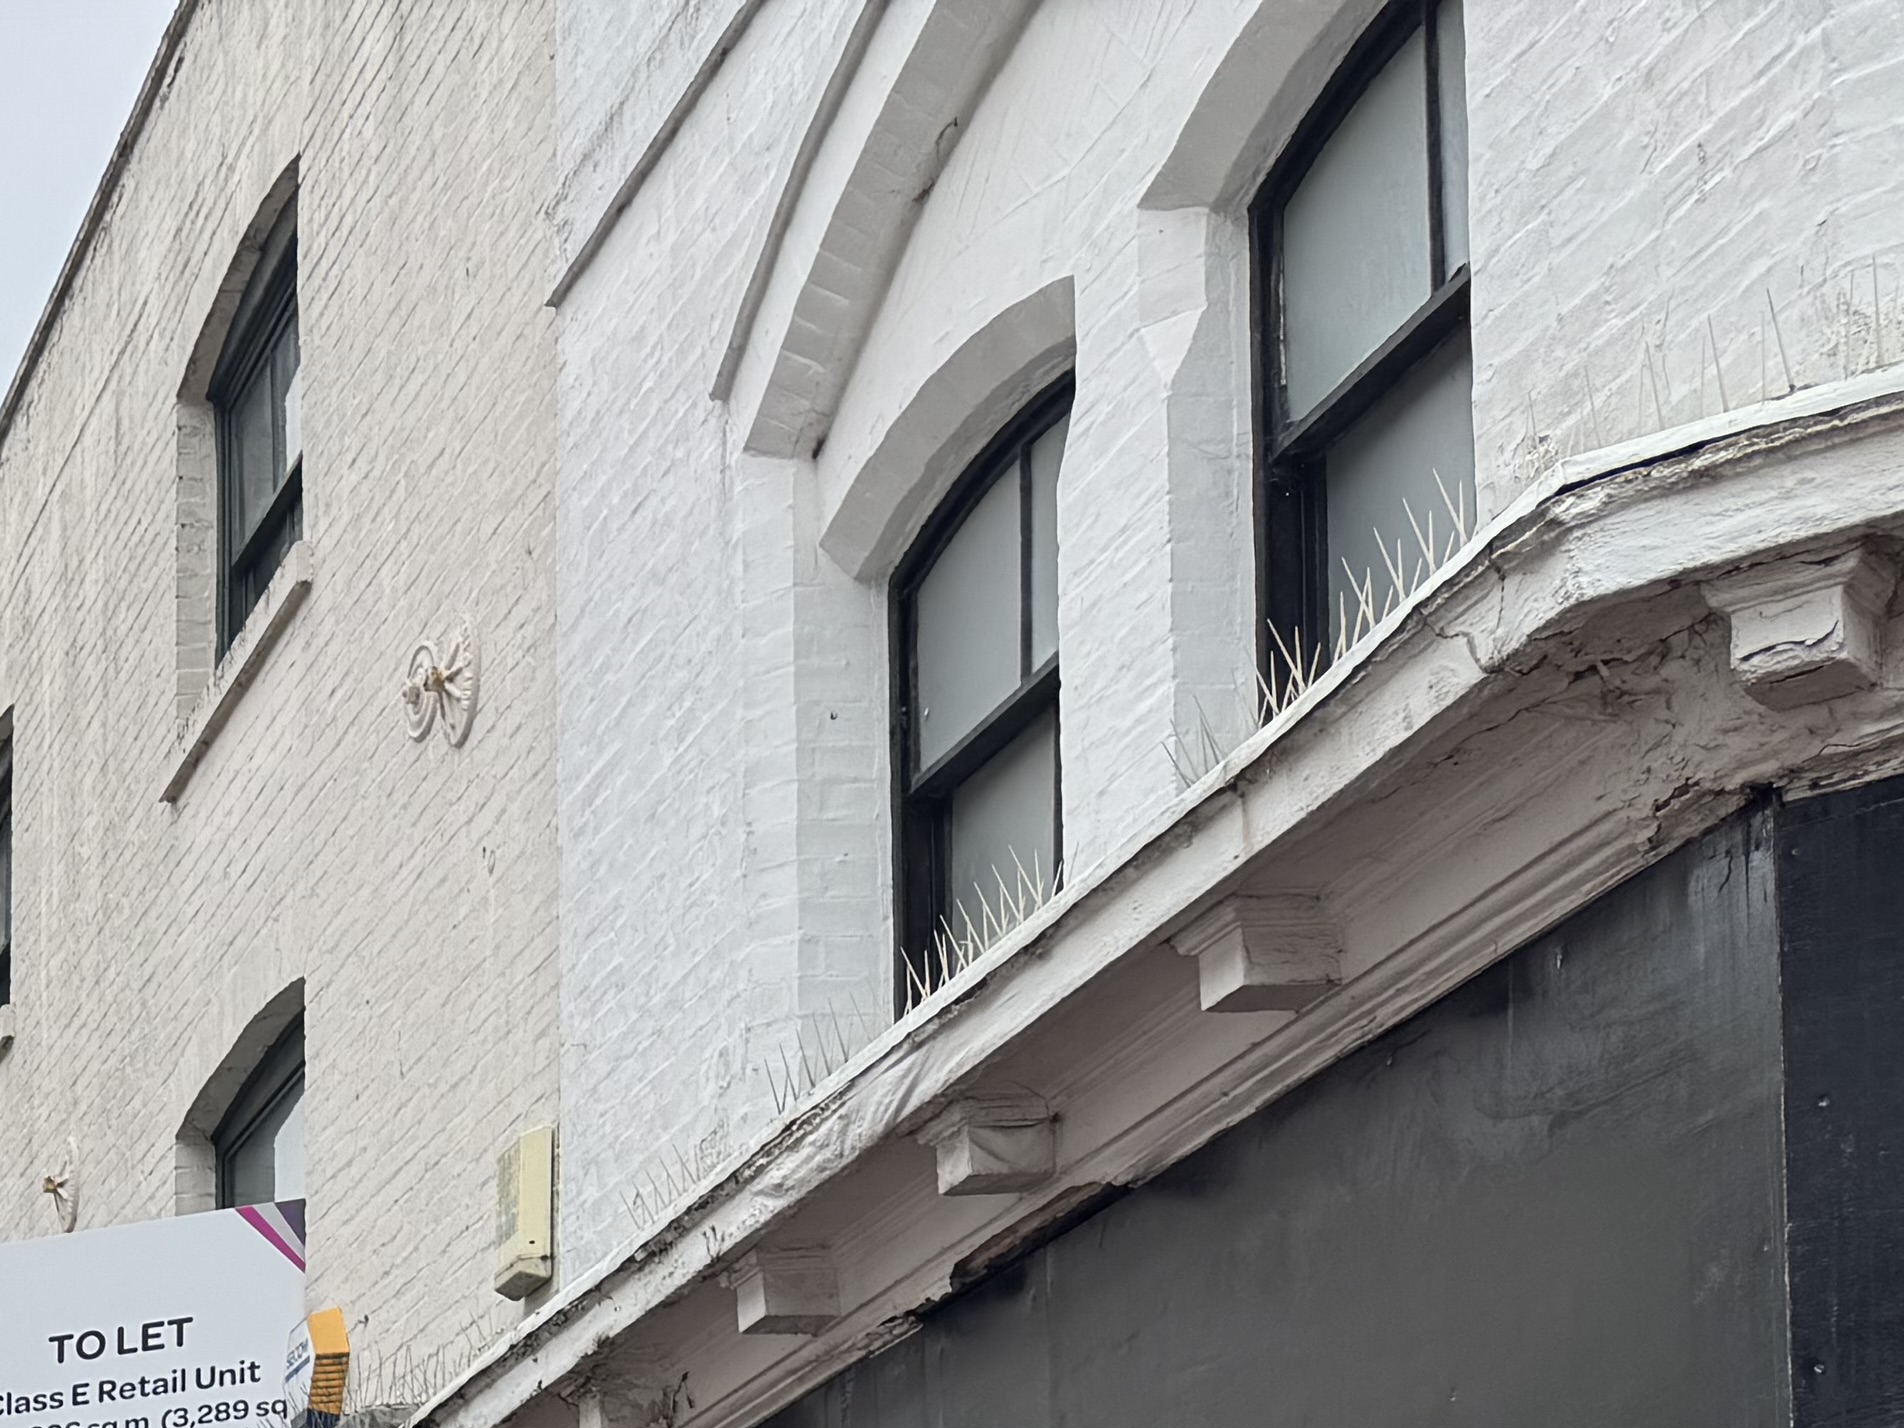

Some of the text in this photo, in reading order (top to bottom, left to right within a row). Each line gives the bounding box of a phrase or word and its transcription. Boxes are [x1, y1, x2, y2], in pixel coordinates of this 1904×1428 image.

[48, 1316, 194, 1364] TO LET
[71, 1382, 90, 1407] E
[98, 1368, 187, 1402] Retail
[195, 1359, 262, 1391] Unit
